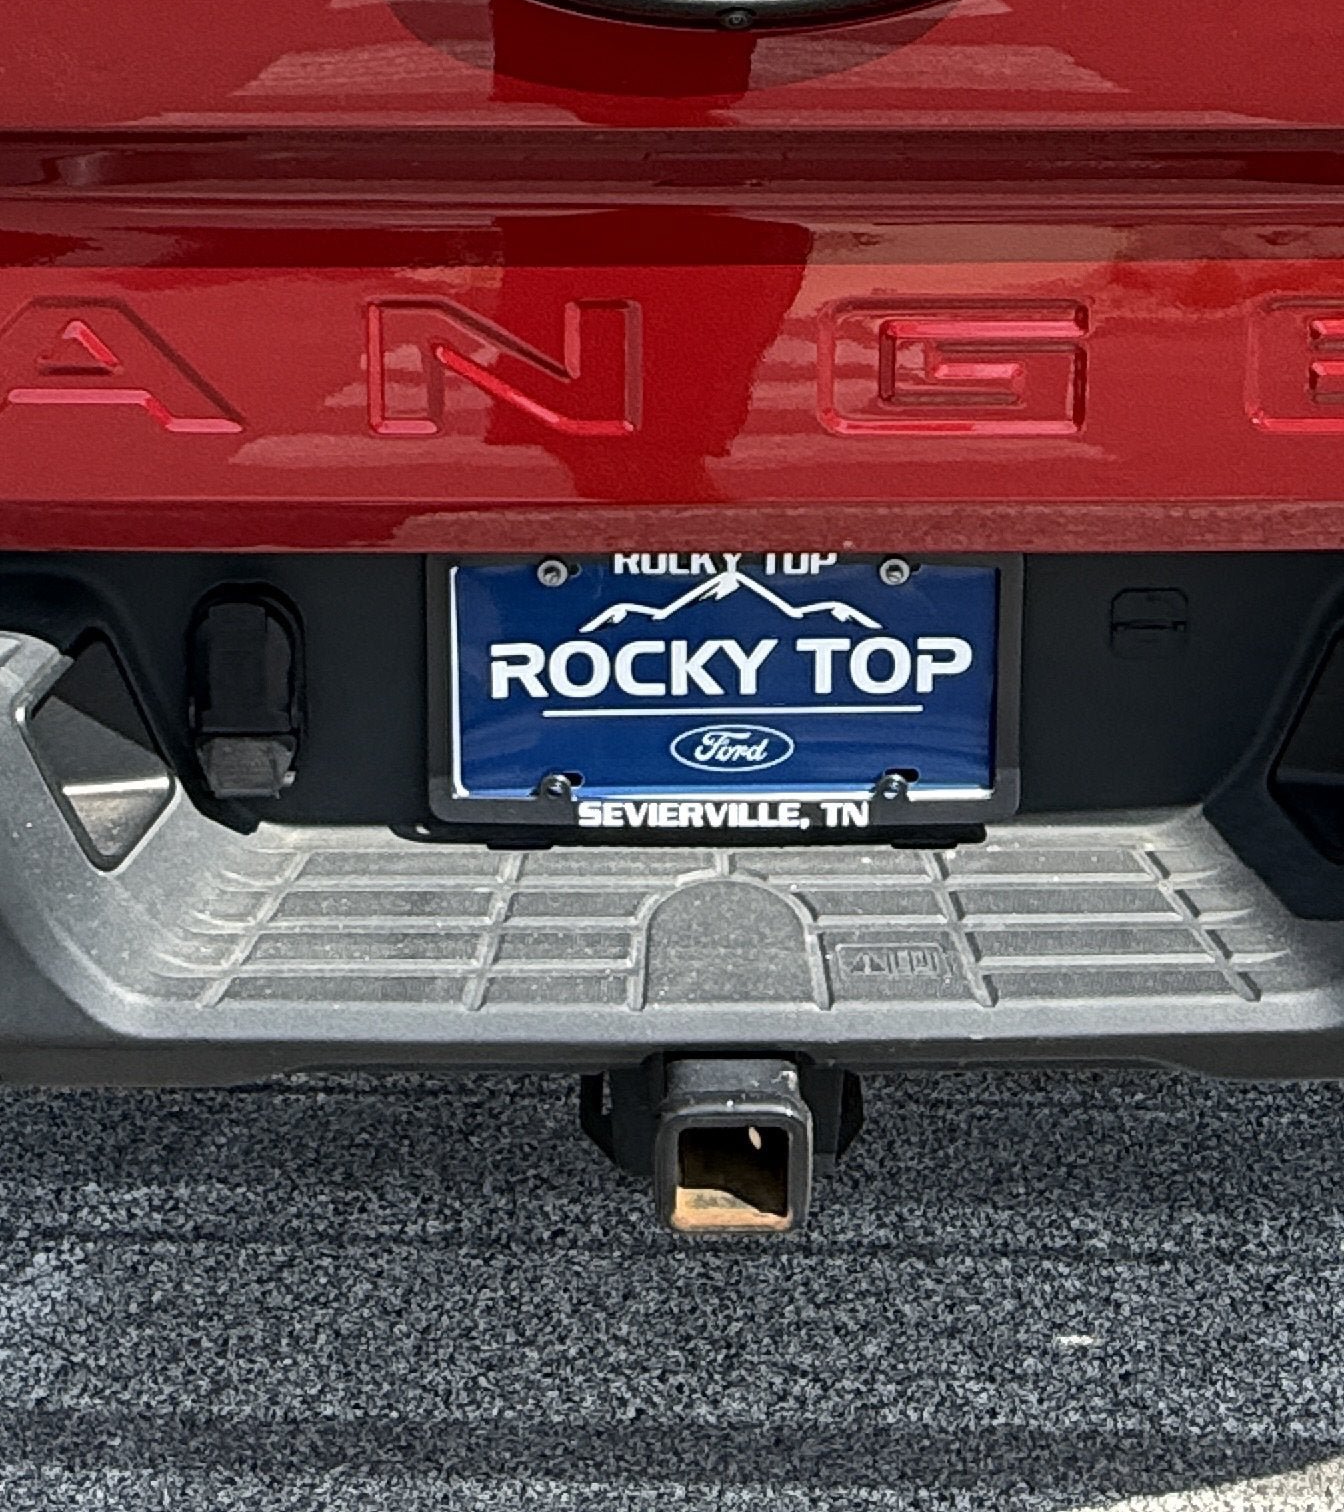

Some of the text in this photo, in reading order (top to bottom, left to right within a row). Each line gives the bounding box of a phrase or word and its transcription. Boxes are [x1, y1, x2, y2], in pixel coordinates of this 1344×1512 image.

[489, 636, 973, 700] ROCKY TOP
[694, 730, 770, 762] Ford
[577, 800, 870, 830] SEVIERVILLE, TN
